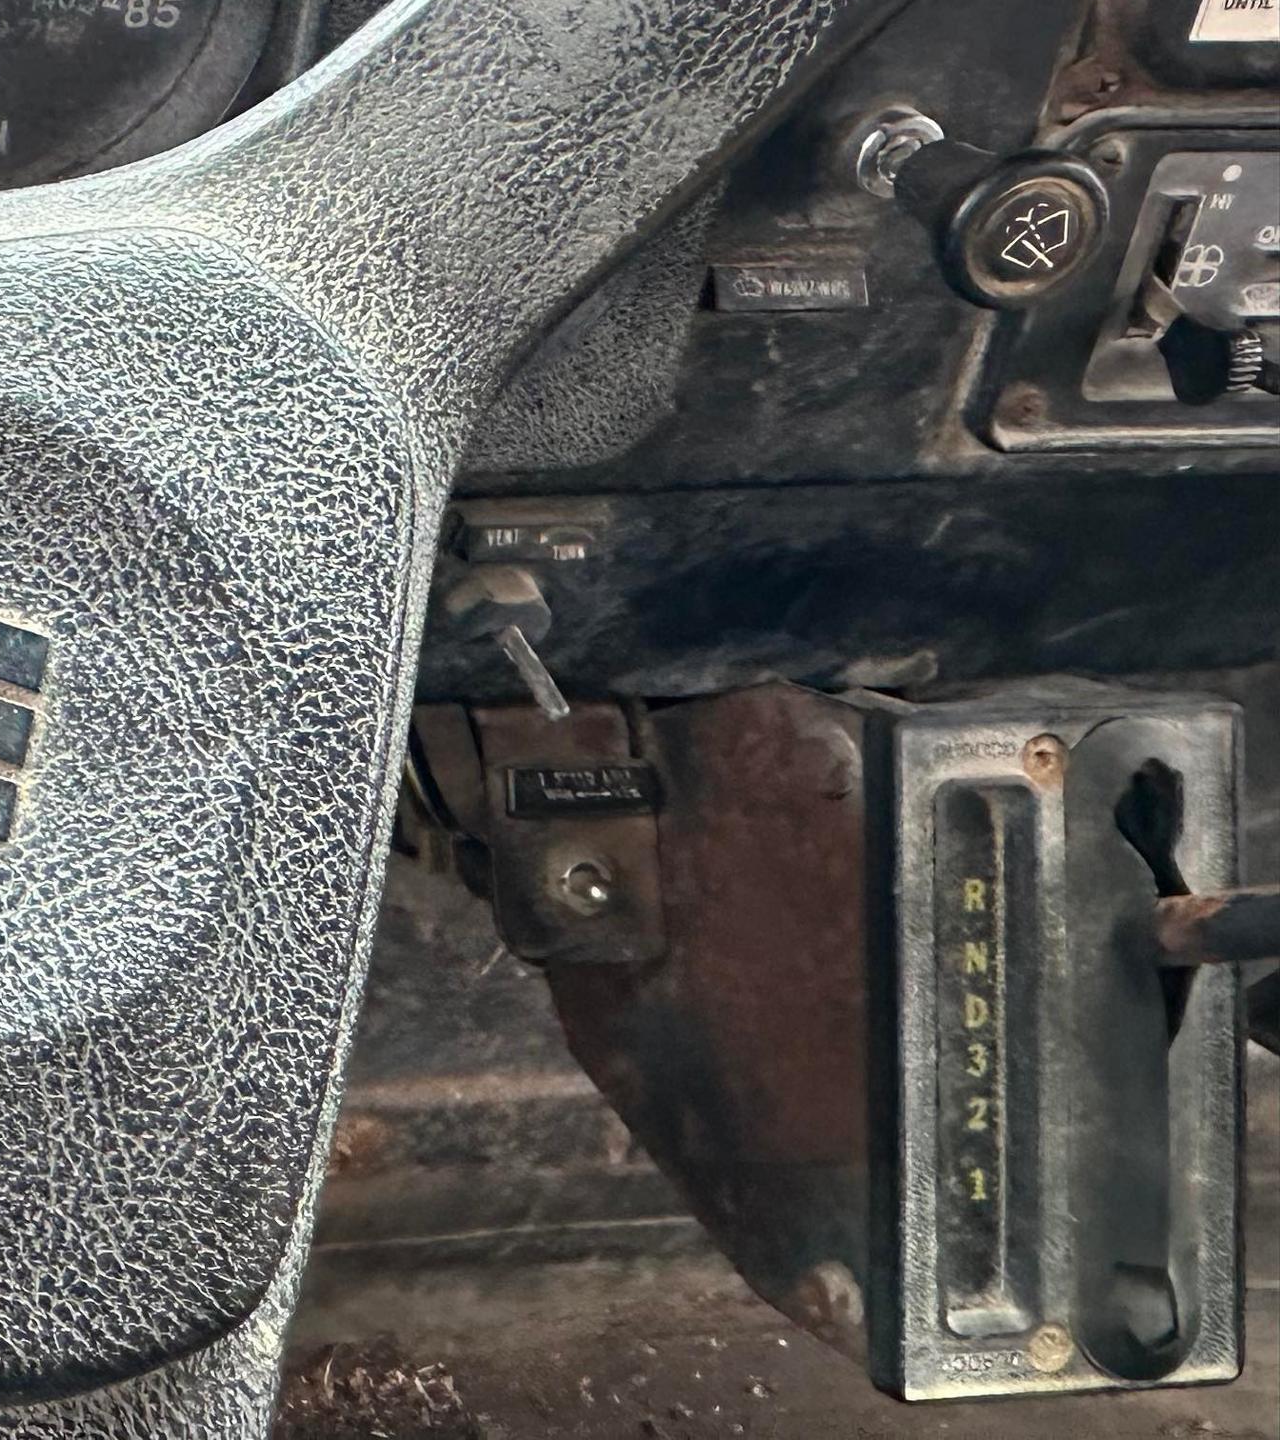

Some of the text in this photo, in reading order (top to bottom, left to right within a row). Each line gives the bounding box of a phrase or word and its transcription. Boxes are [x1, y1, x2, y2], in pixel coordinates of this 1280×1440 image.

[965, 878, 986, 912] R
[965, 941, 988, 975] N
[965, 992, 989, 1029] D
[966, 1043, 989, 1078] 3
[968, 1096, 989, 1131] 2
[970, 1167, 987, 1200] 1
